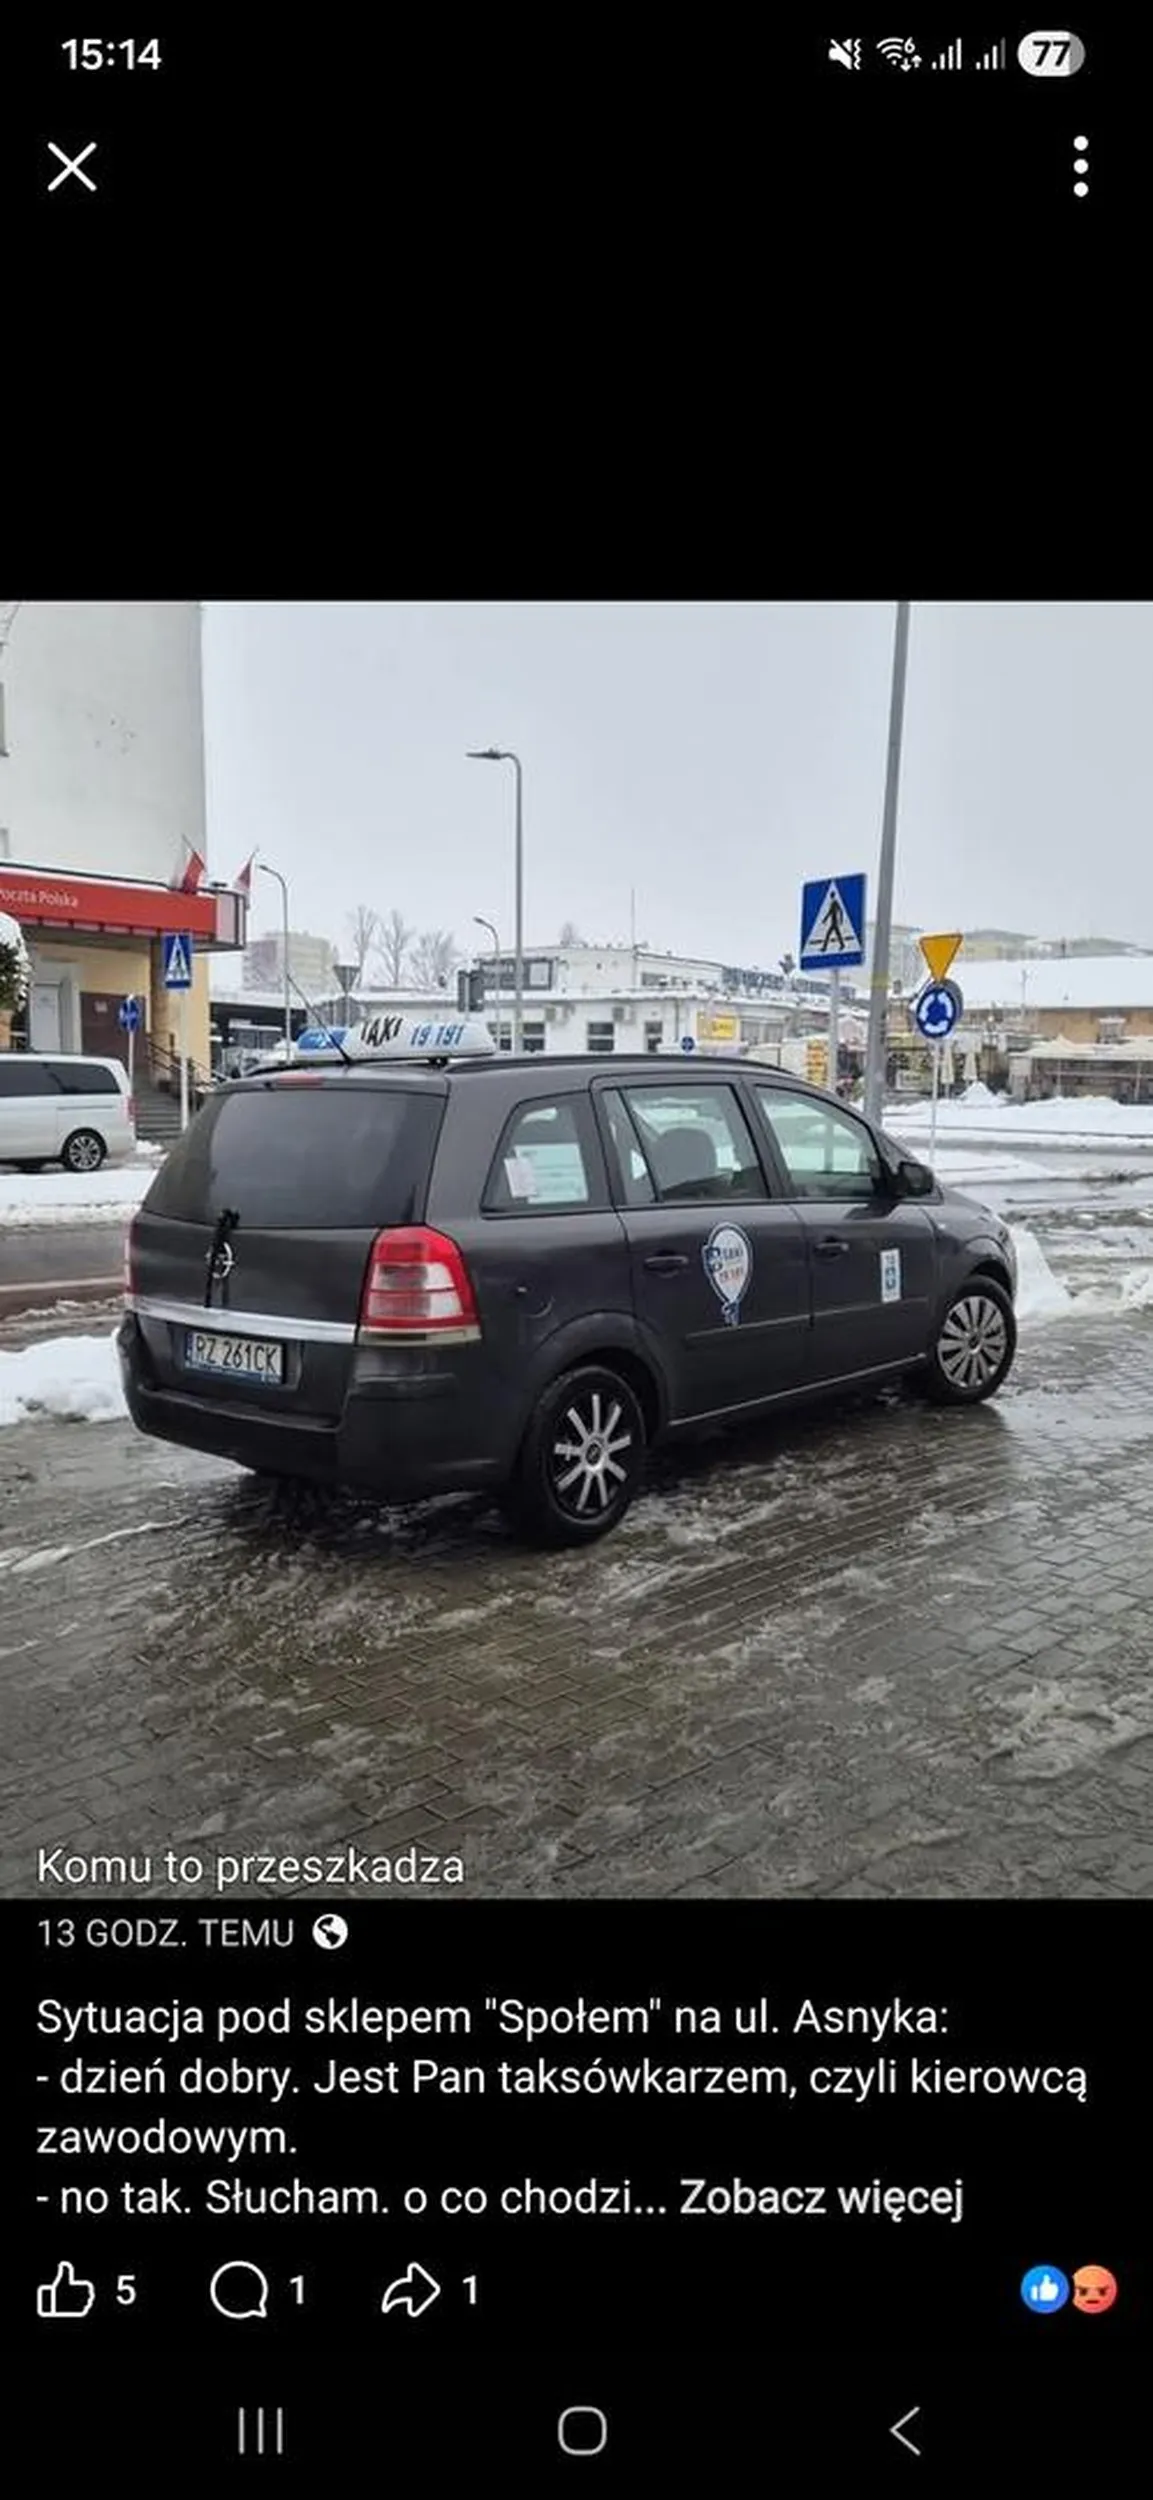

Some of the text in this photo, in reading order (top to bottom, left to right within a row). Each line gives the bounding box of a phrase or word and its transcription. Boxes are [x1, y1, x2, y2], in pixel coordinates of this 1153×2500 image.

[38, 889, 79, 908] Polska
[360, 1016, 466, 1046] TAXI 19 191
[195, 1334, 278, 1374] RZ 261CK
